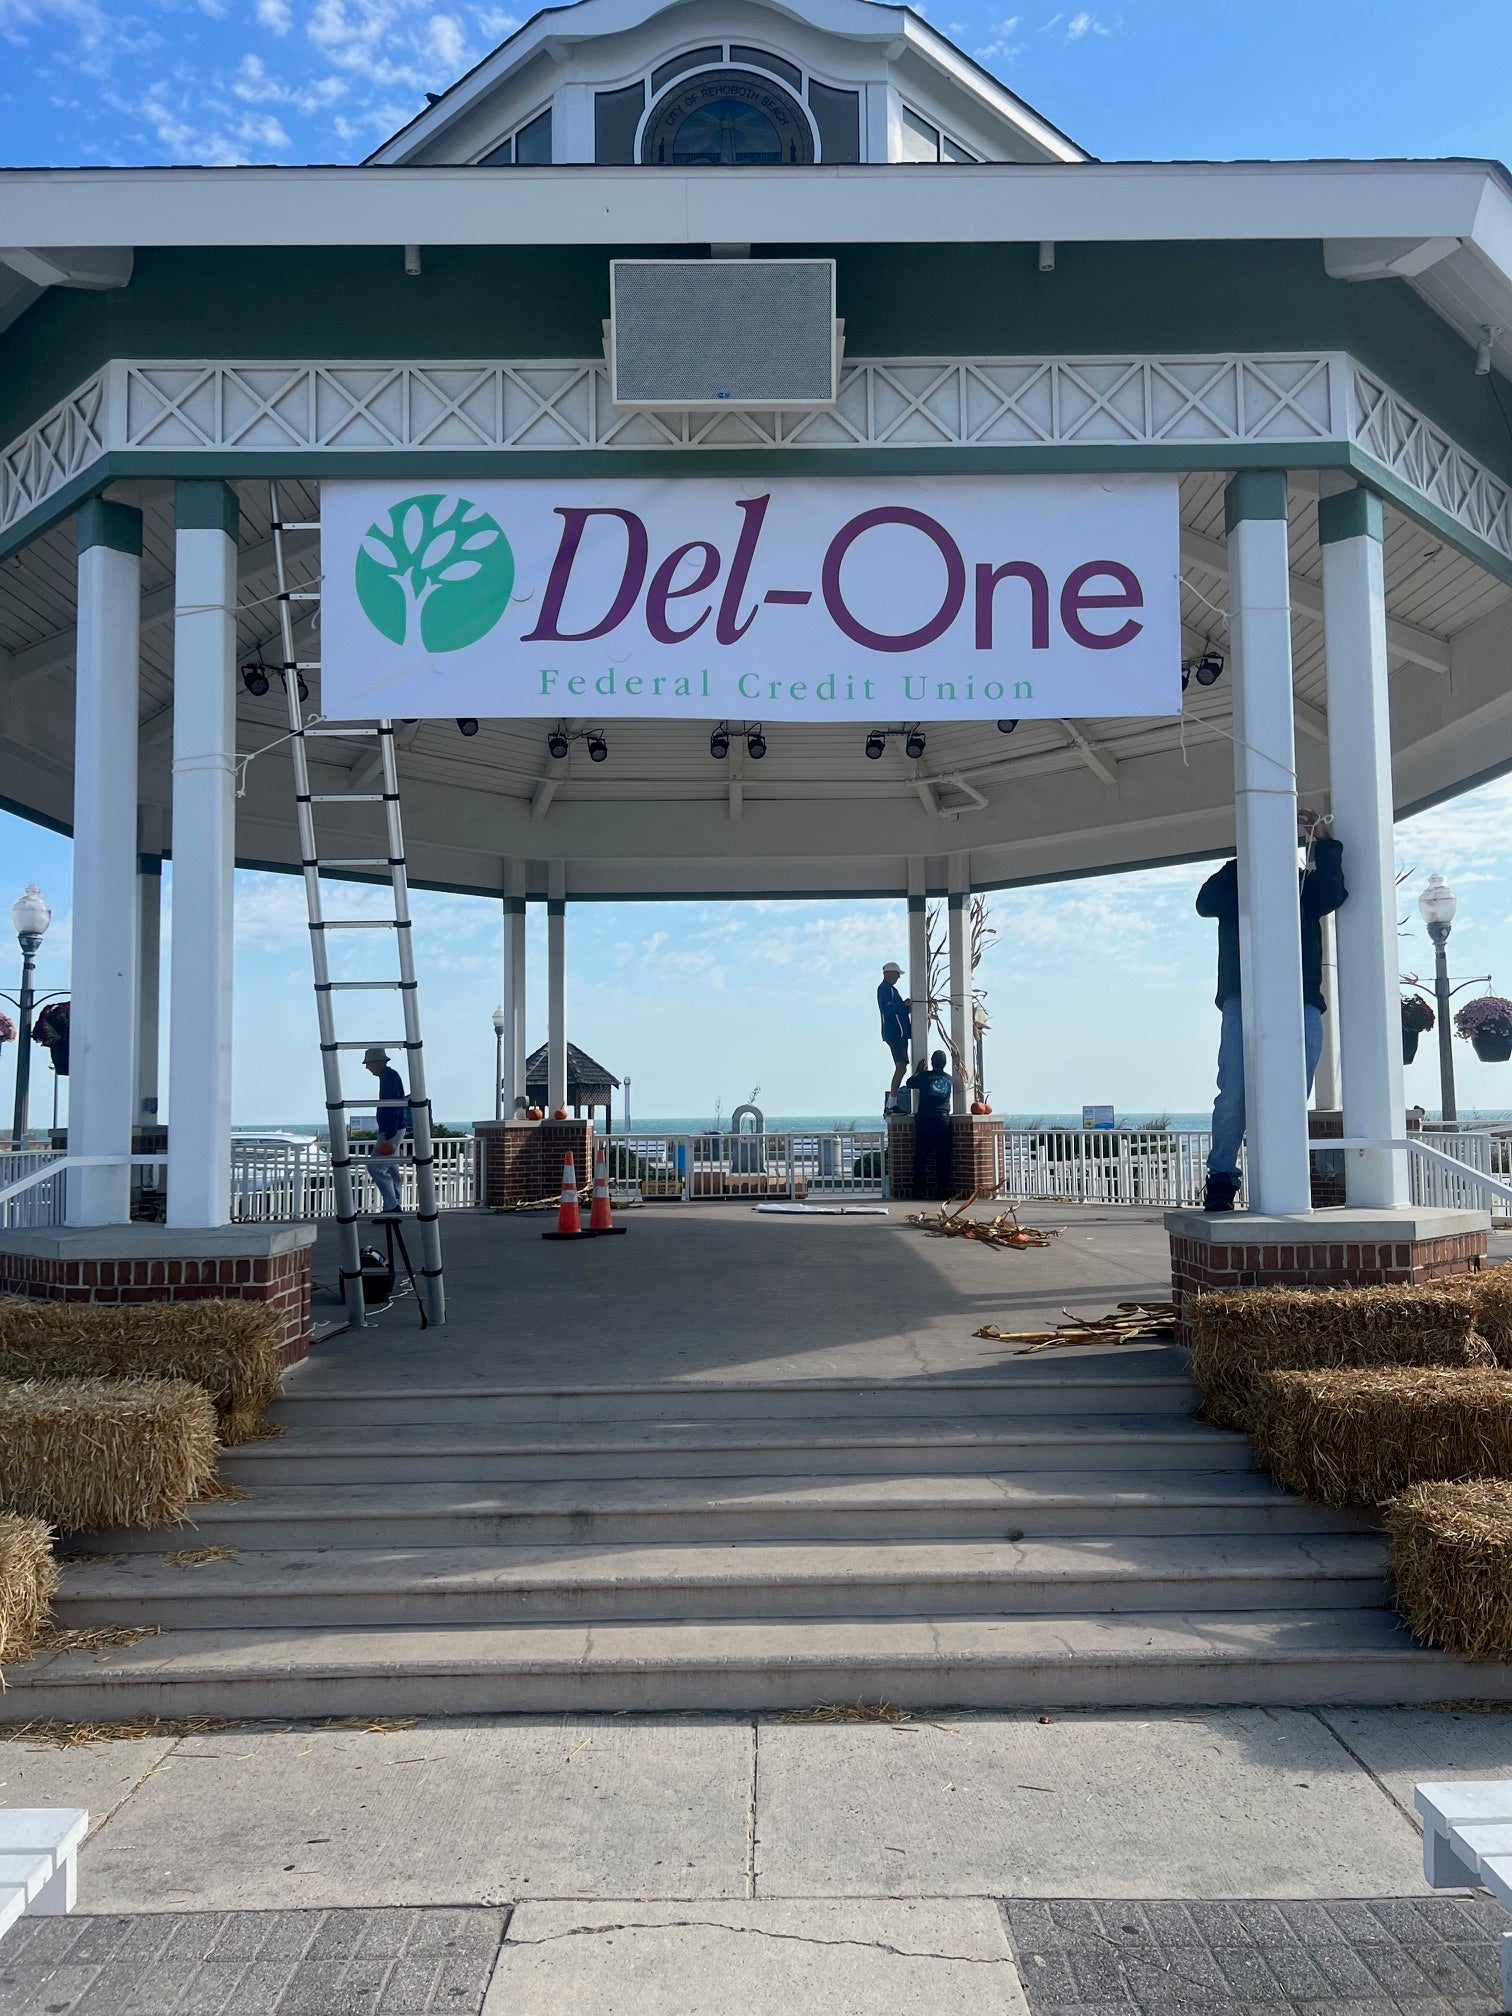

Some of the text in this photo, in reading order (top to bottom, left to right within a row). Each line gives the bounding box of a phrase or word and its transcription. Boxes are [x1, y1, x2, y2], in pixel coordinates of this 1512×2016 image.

[666, 86, 790, 126] CITY OF REHOBOTH BEACH
[519, 494, 1145, 653] Del-One
[538, 667, 1035, 704] Federal Credit Union
